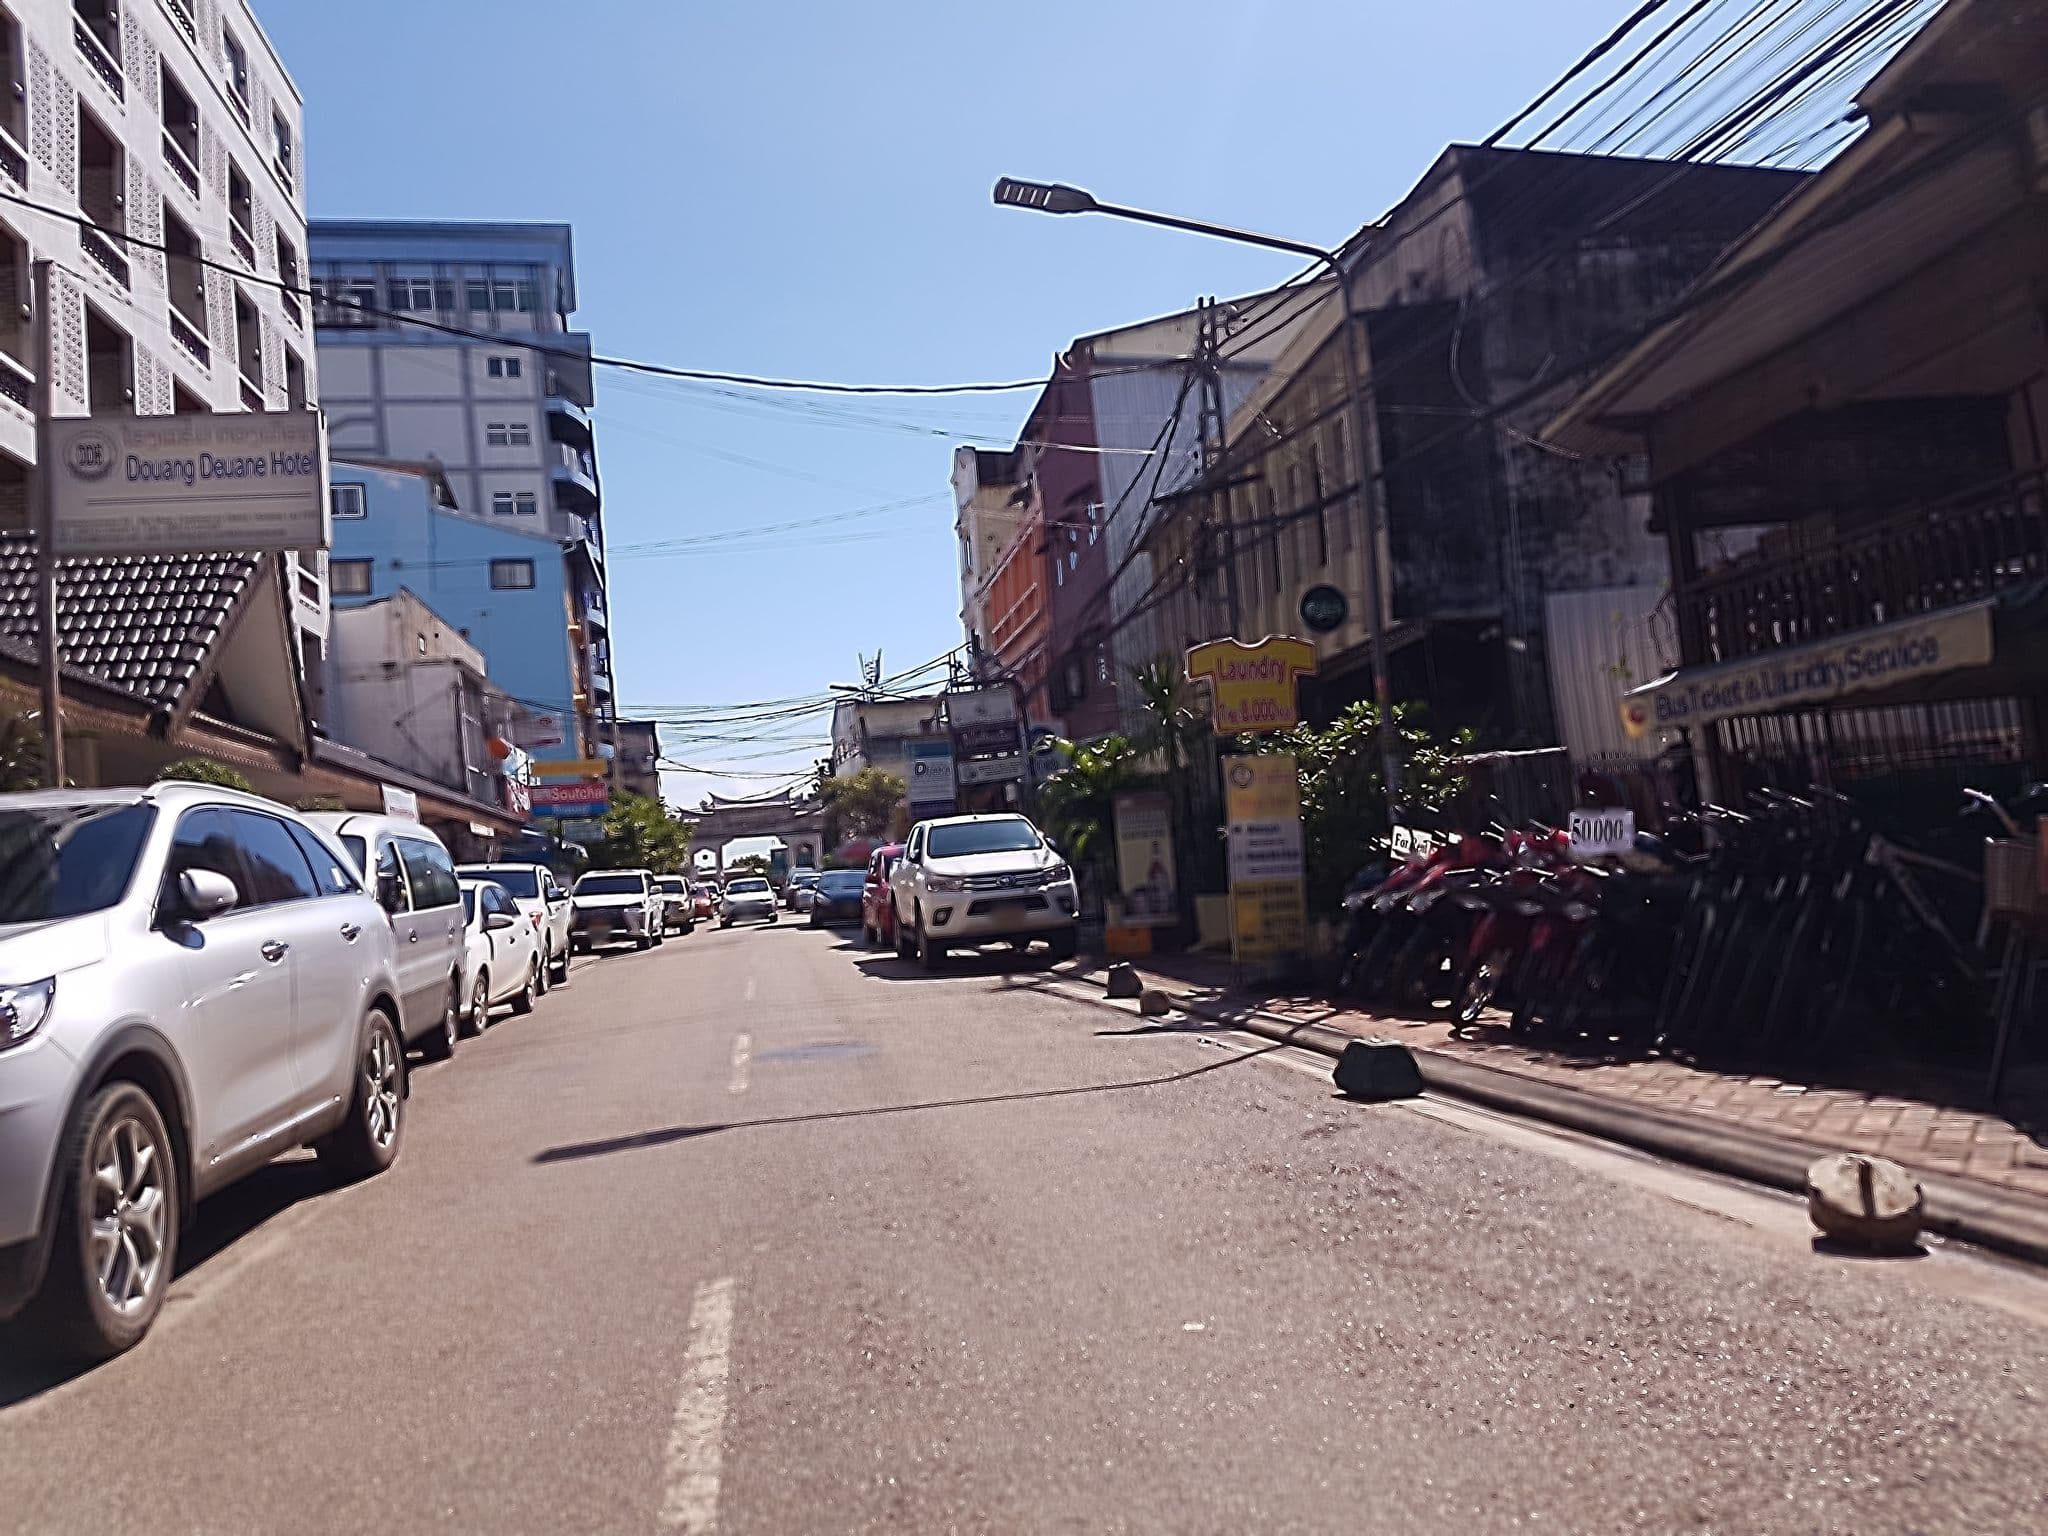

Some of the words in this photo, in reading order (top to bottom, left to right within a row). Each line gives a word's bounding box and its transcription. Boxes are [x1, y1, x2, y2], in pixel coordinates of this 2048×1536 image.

[126, 455, 195, 486] Douang
[200, 453, 266, 478] Deuane
[271, 450, 316, 476] Hotel
[1218, 656, 1286, 684] Laundry
[1656, 693, 1688, 721] Bus
[1762, 658, 1846, 702] Laundry
[1847, 636, 1938, 680] Service
[1395, 833, 1408, 848] For
